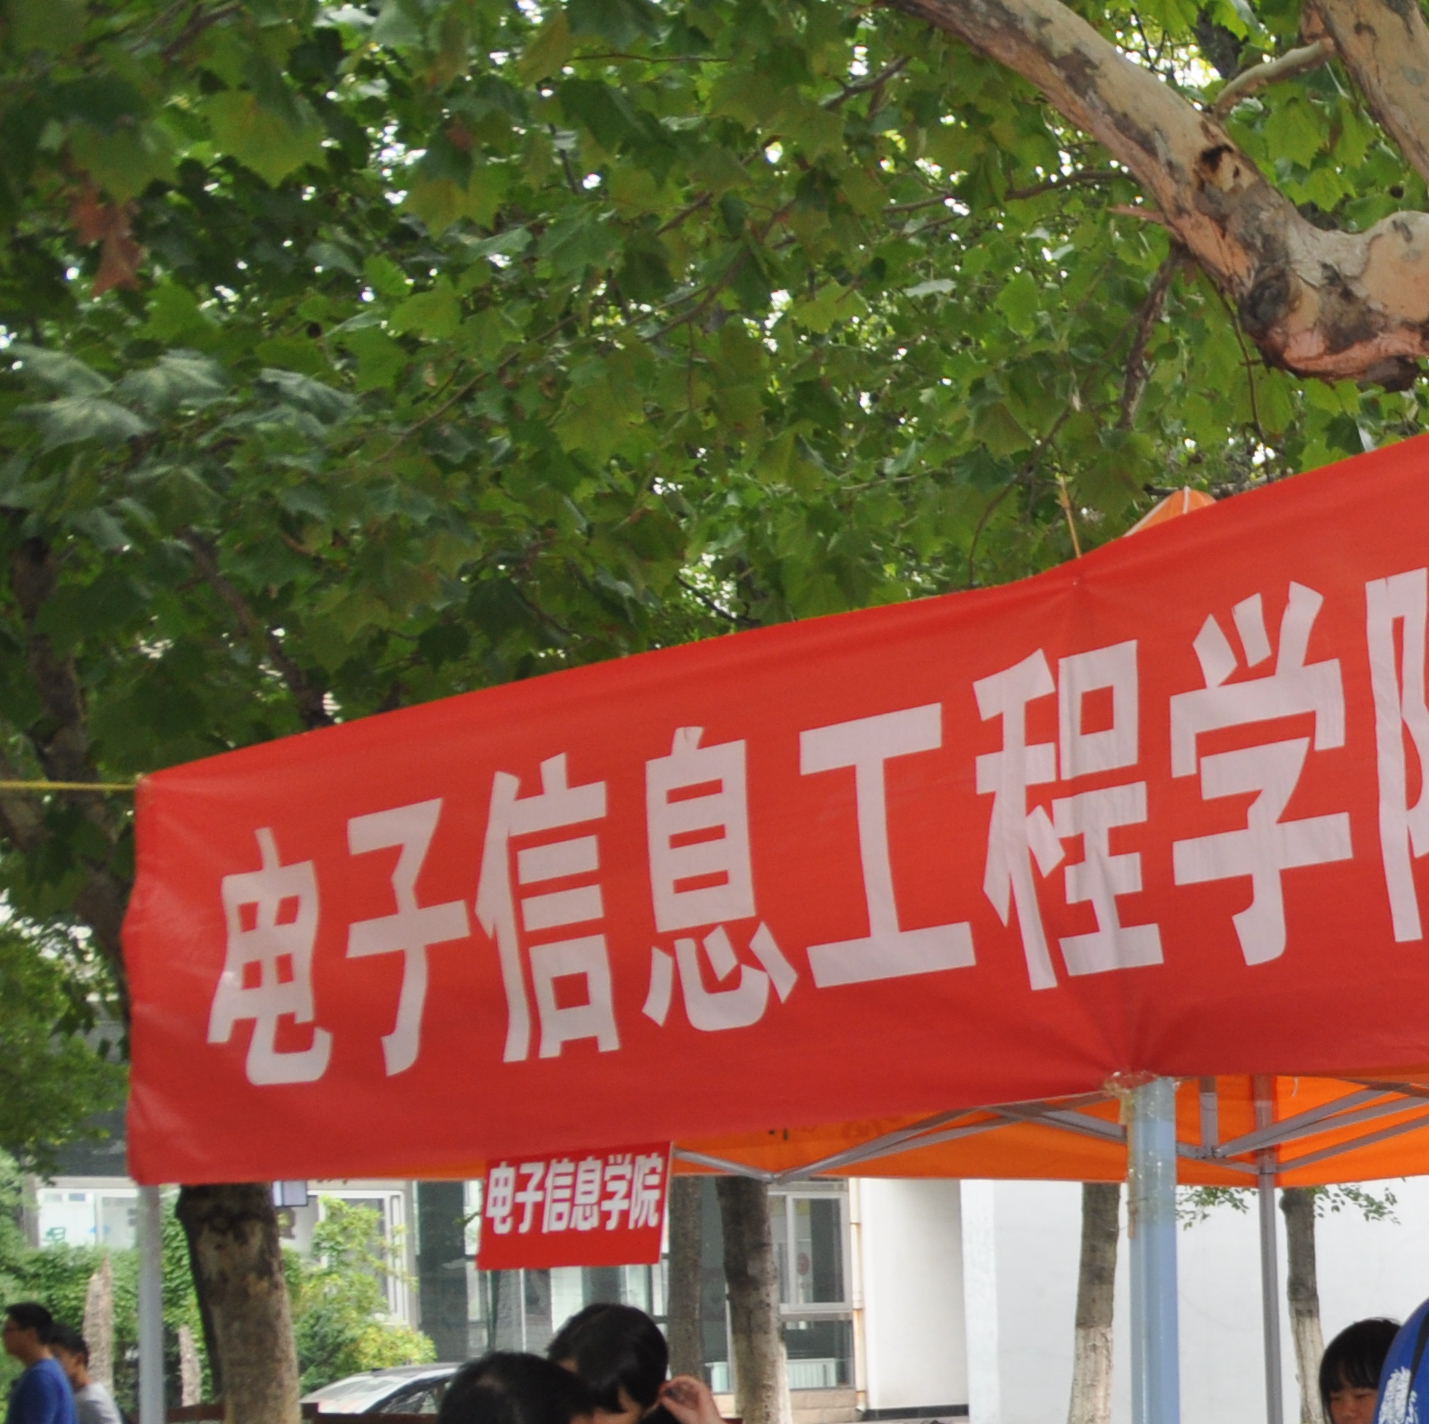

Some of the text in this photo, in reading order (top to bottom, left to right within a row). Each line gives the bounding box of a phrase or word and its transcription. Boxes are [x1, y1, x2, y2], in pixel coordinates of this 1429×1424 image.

[484, 1151, 664, 1236] 电子信息学院
